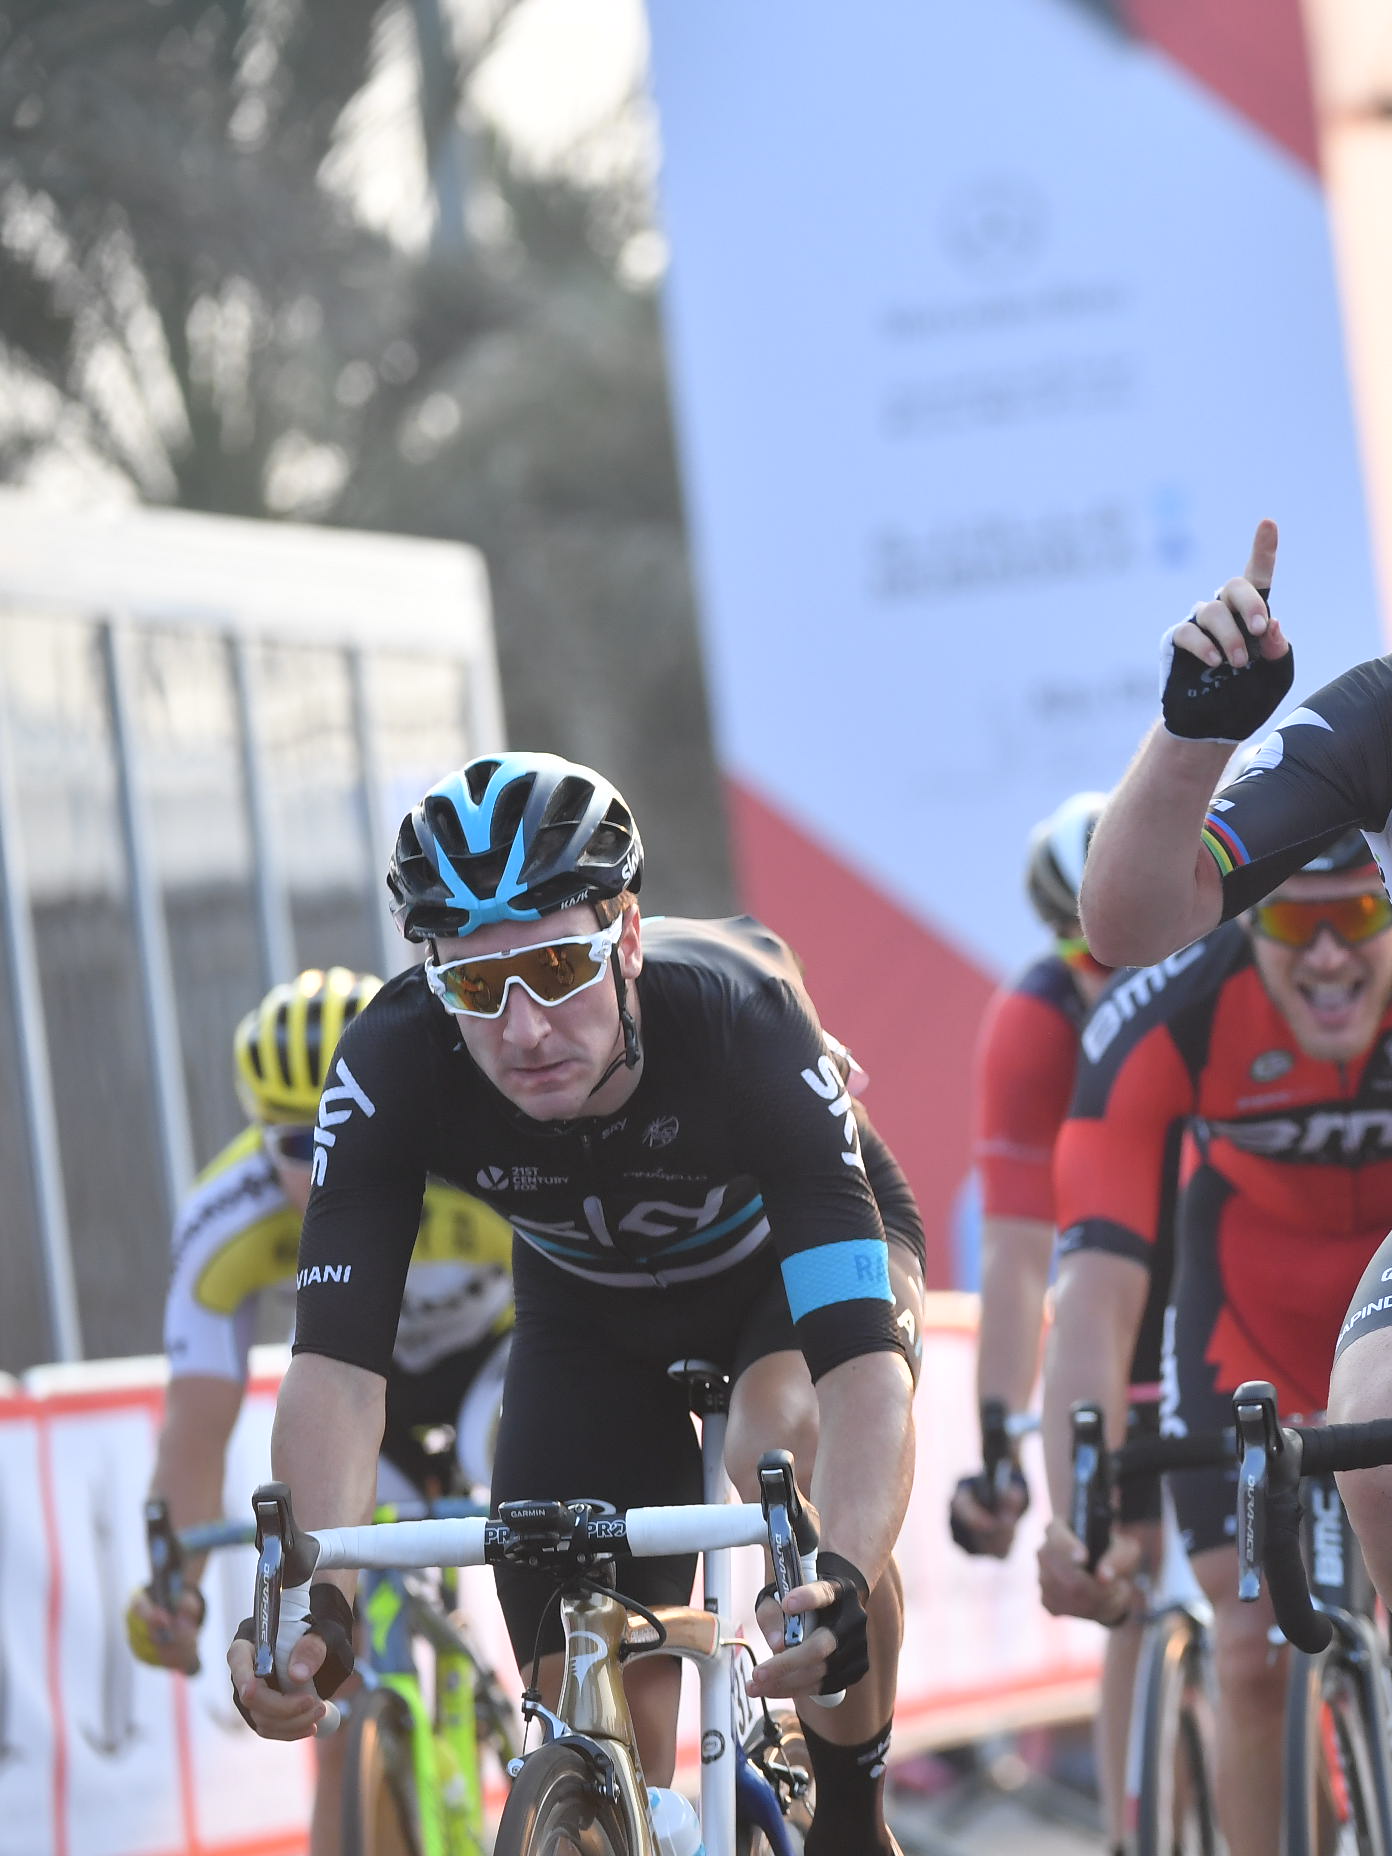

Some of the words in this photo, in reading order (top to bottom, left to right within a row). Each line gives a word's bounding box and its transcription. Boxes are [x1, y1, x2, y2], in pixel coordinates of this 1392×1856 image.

[511, 1509, 546, 1518] GARMIN
[484, 1526, 510, 1545] PR
[260, 1563, 273, 1643] DURA-ACE
